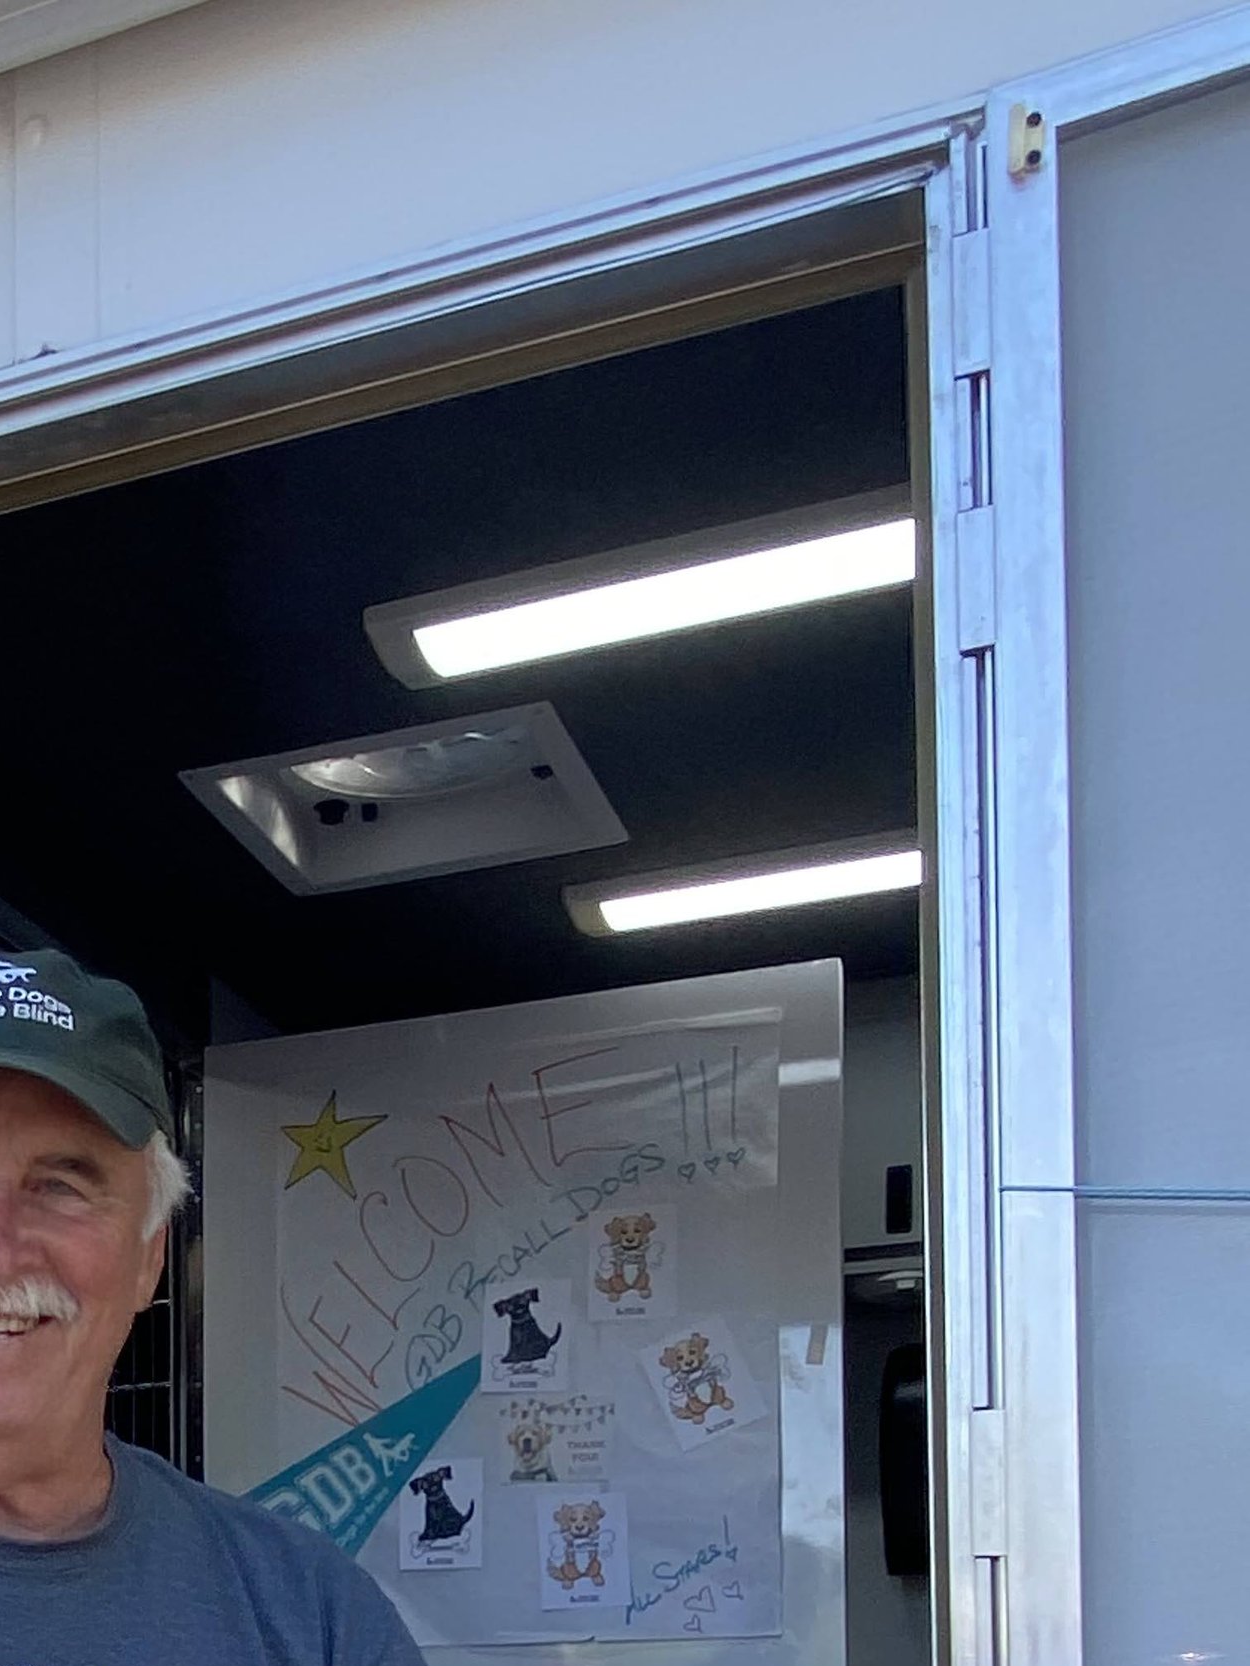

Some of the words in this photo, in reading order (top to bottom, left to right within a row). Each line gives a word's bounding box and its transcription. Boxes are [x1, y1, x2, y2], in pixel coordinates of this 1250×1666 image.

[8, 987, 72, 1015] Dogs
[13, 1004, 74, 1032] Blind
[405, 1304, 463, 1393] GDB
[552, 1142, 665, 1222] DOGS
